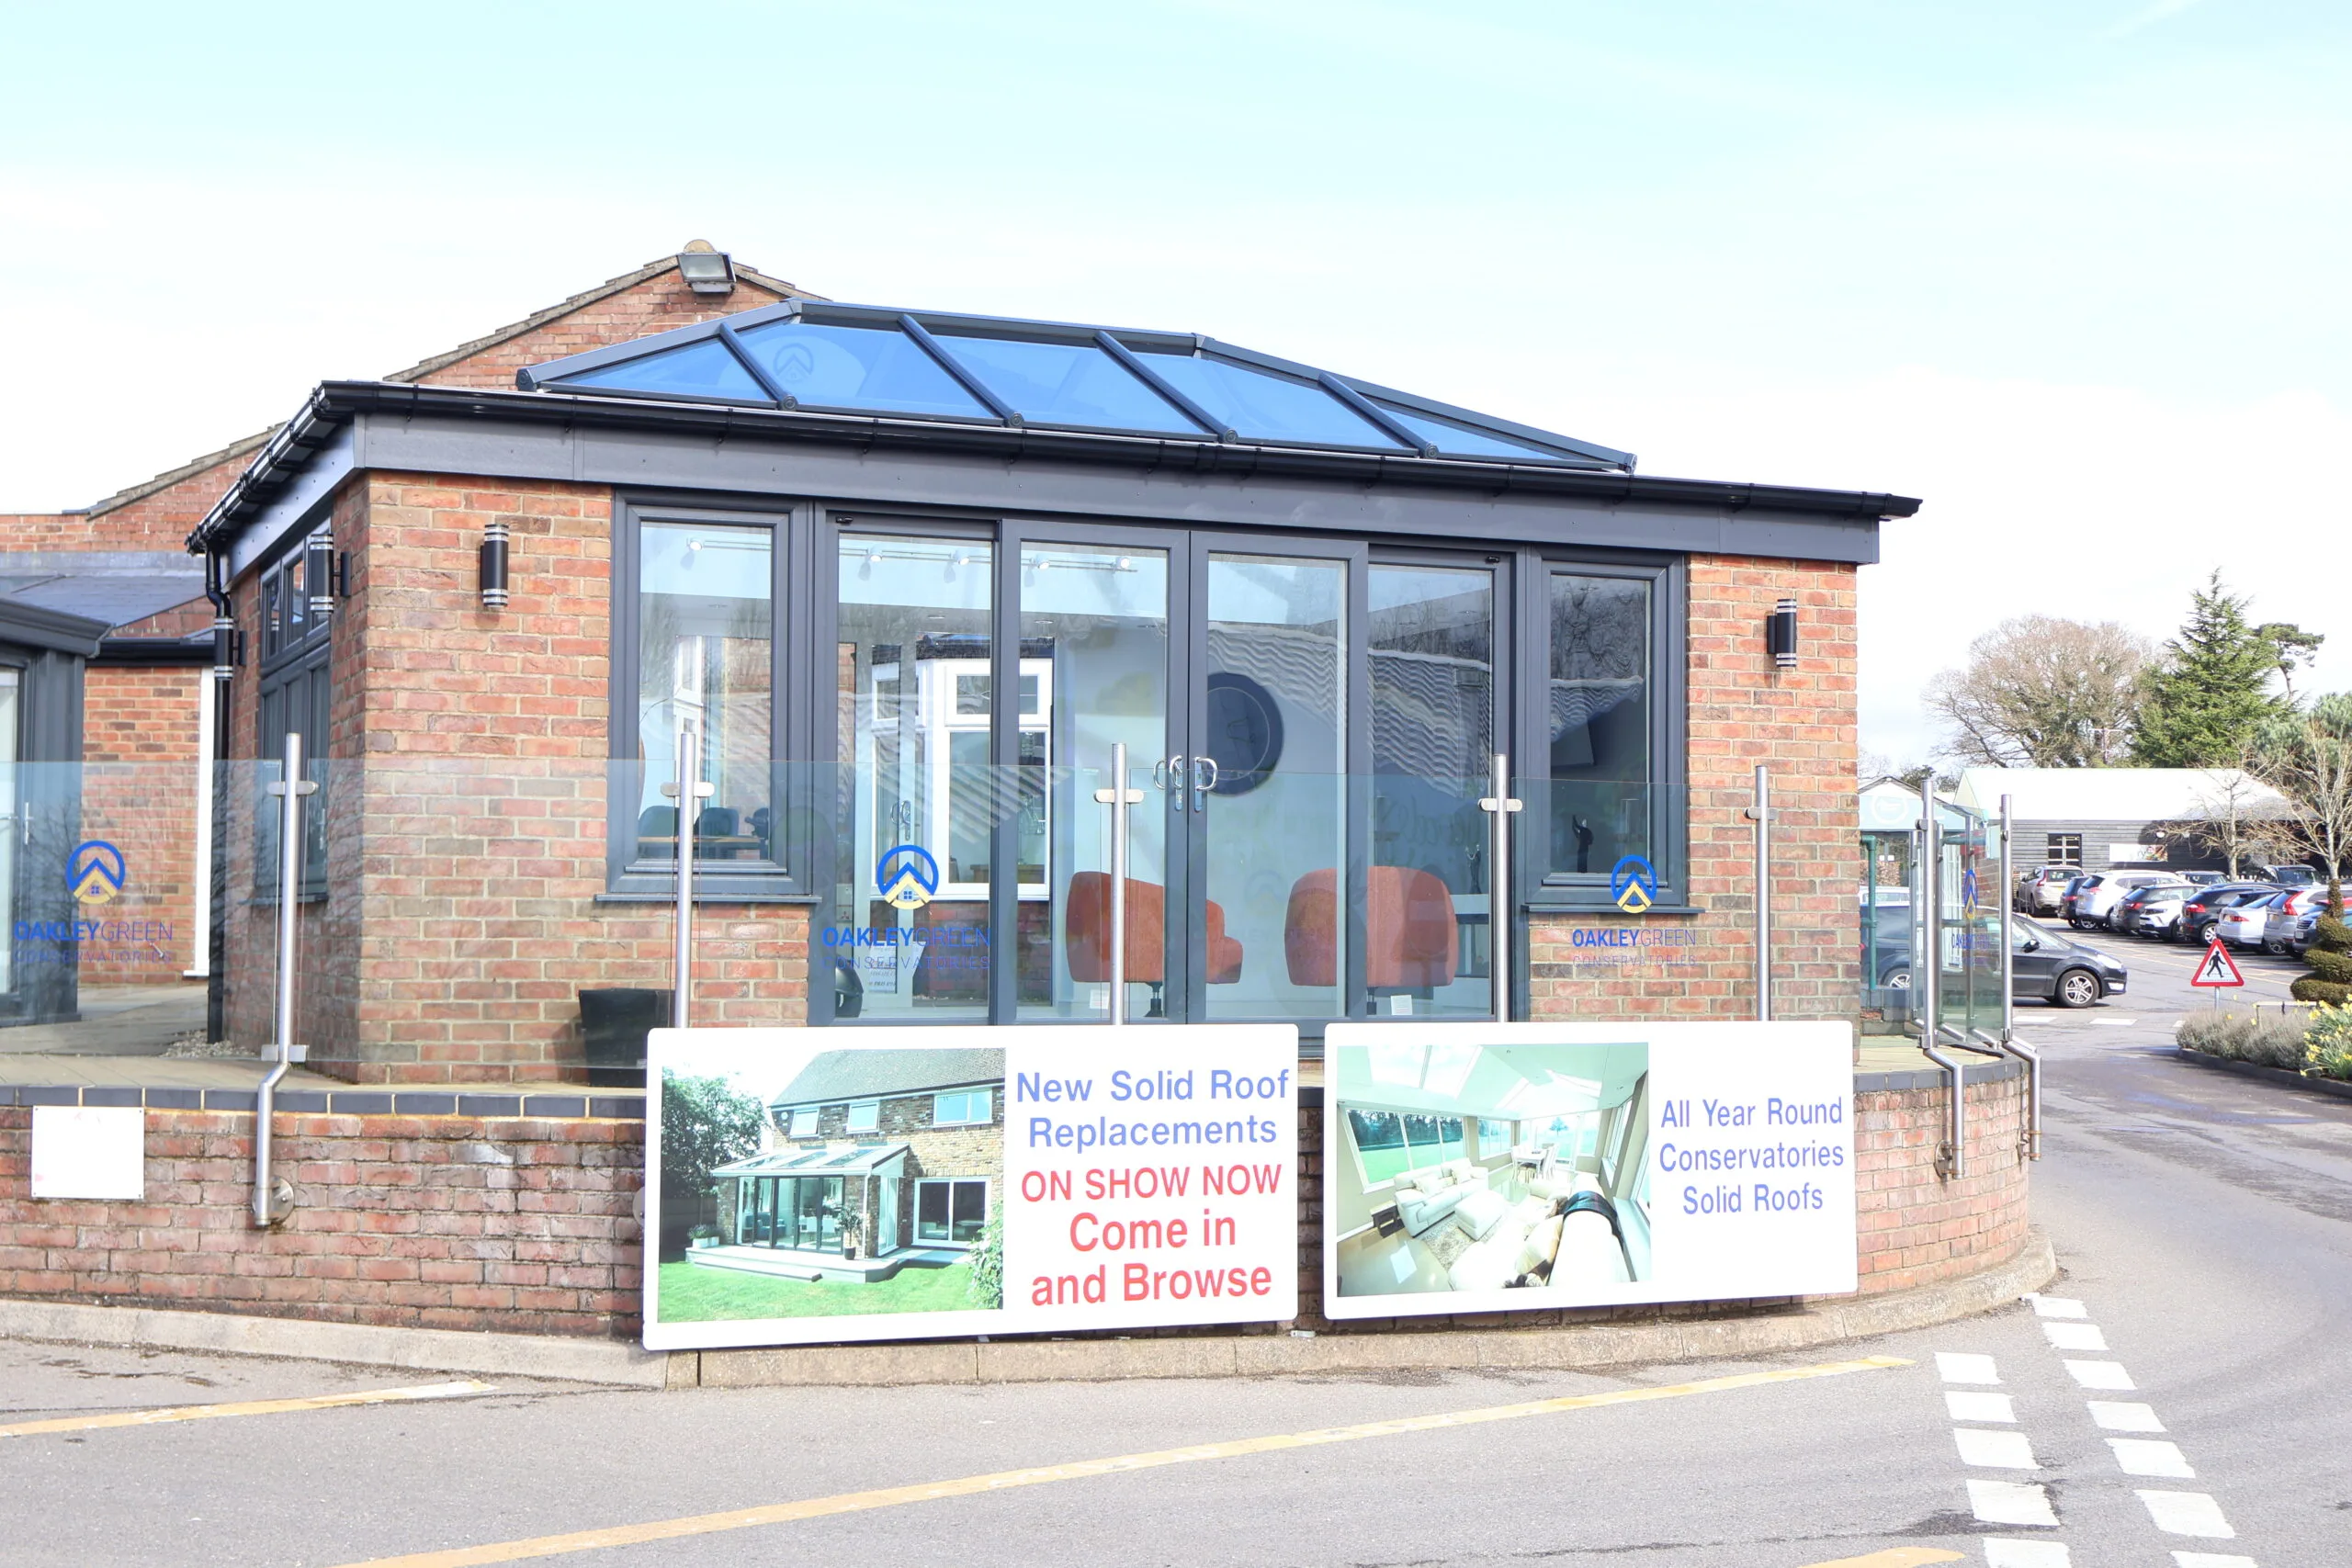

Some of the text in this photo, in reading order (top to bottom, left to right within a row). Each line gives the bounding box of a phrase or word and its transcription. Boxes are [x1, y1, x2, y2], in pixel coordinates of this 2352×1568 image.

[14, 921, 173, 941] OAKLEYGREEN
[821, 927, 990, 947] OAKLEYGREEN
[1572, 929, 1696, 947] OAKLEYGREEN
[14, 950, 173, 964] CONSERVATORIES
[821, 956, 990, 969] CONSERVATORIES
[1572, 955, 1697, 967] CONSERVATORIES
[1017, 1068, 1289, 1102] New Solid Roof
[1661, 1097, 1843, 1127] All Year Round
[1030, 1115, 1277, 1154] Replacements
[1659, 1140, 1844, 1172] Conservatories
[1021, 1164, 1283, 1202] ON SHOW NOW
[1683, 1182, 1823, 1215] Solid Roofs
[1069, 1208, 1236, 1253] Come in
[1032, 1262, 1272, 1307] and Browse
